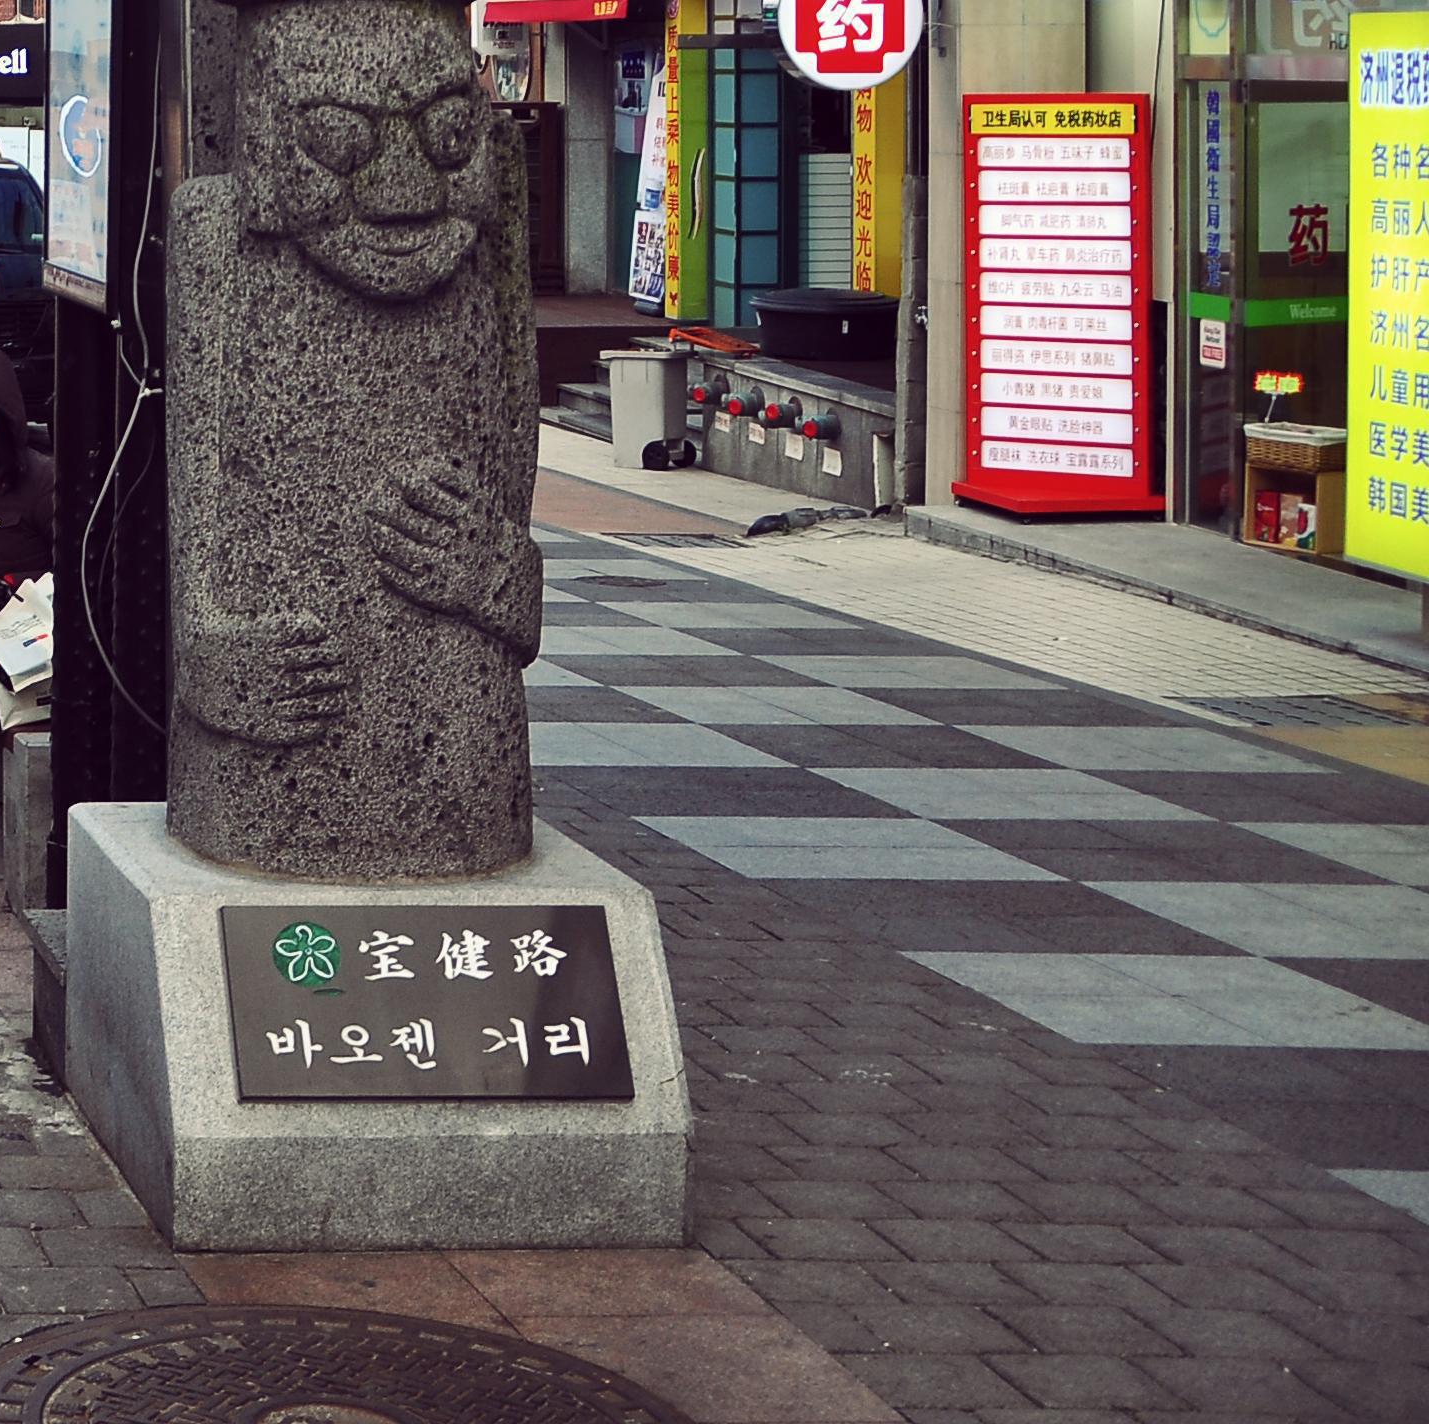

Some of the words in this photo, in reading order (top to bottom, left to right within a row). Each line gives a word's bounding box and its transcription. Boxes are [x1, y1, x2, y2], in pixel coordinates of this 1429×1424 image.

[982, 109, 1048, 128] 卫生局认可
[1054, 109, 1122, 128] 免税药妆店
[1288, 203, 1329, 267] 药
[1289, 303, 1337, 320] Welcome
[357, 928, 568, 982] 宝健路
[266, 1017, 438, 1071] 바오젠
[482, 1015, 591, 1069] 거리
